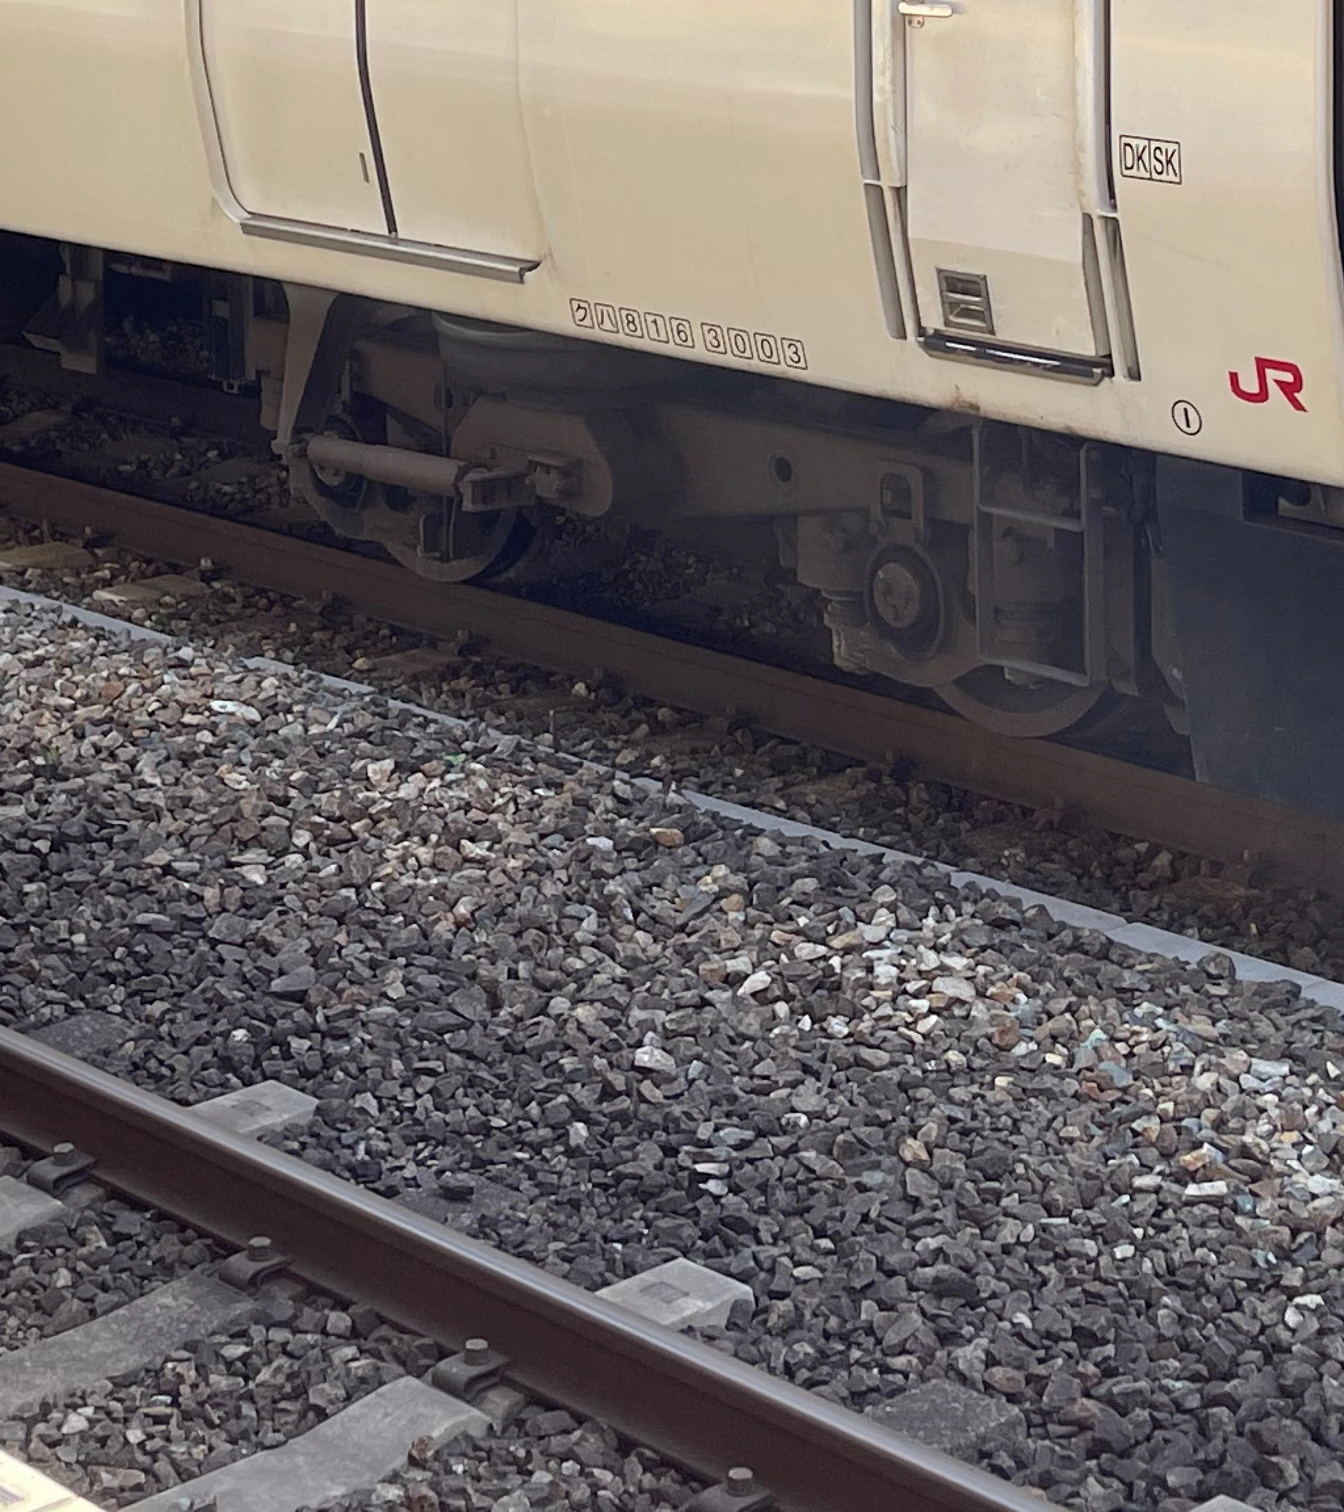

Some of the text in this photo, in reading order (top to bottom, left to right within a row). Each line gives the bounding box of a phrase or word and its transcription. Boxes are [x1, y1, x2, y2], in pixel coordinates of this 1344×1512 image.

[1122, 141, 1179, 178] DK SK
[703, 324, 805, 368] 3003
[1228, 355, 1308, 413] JR
